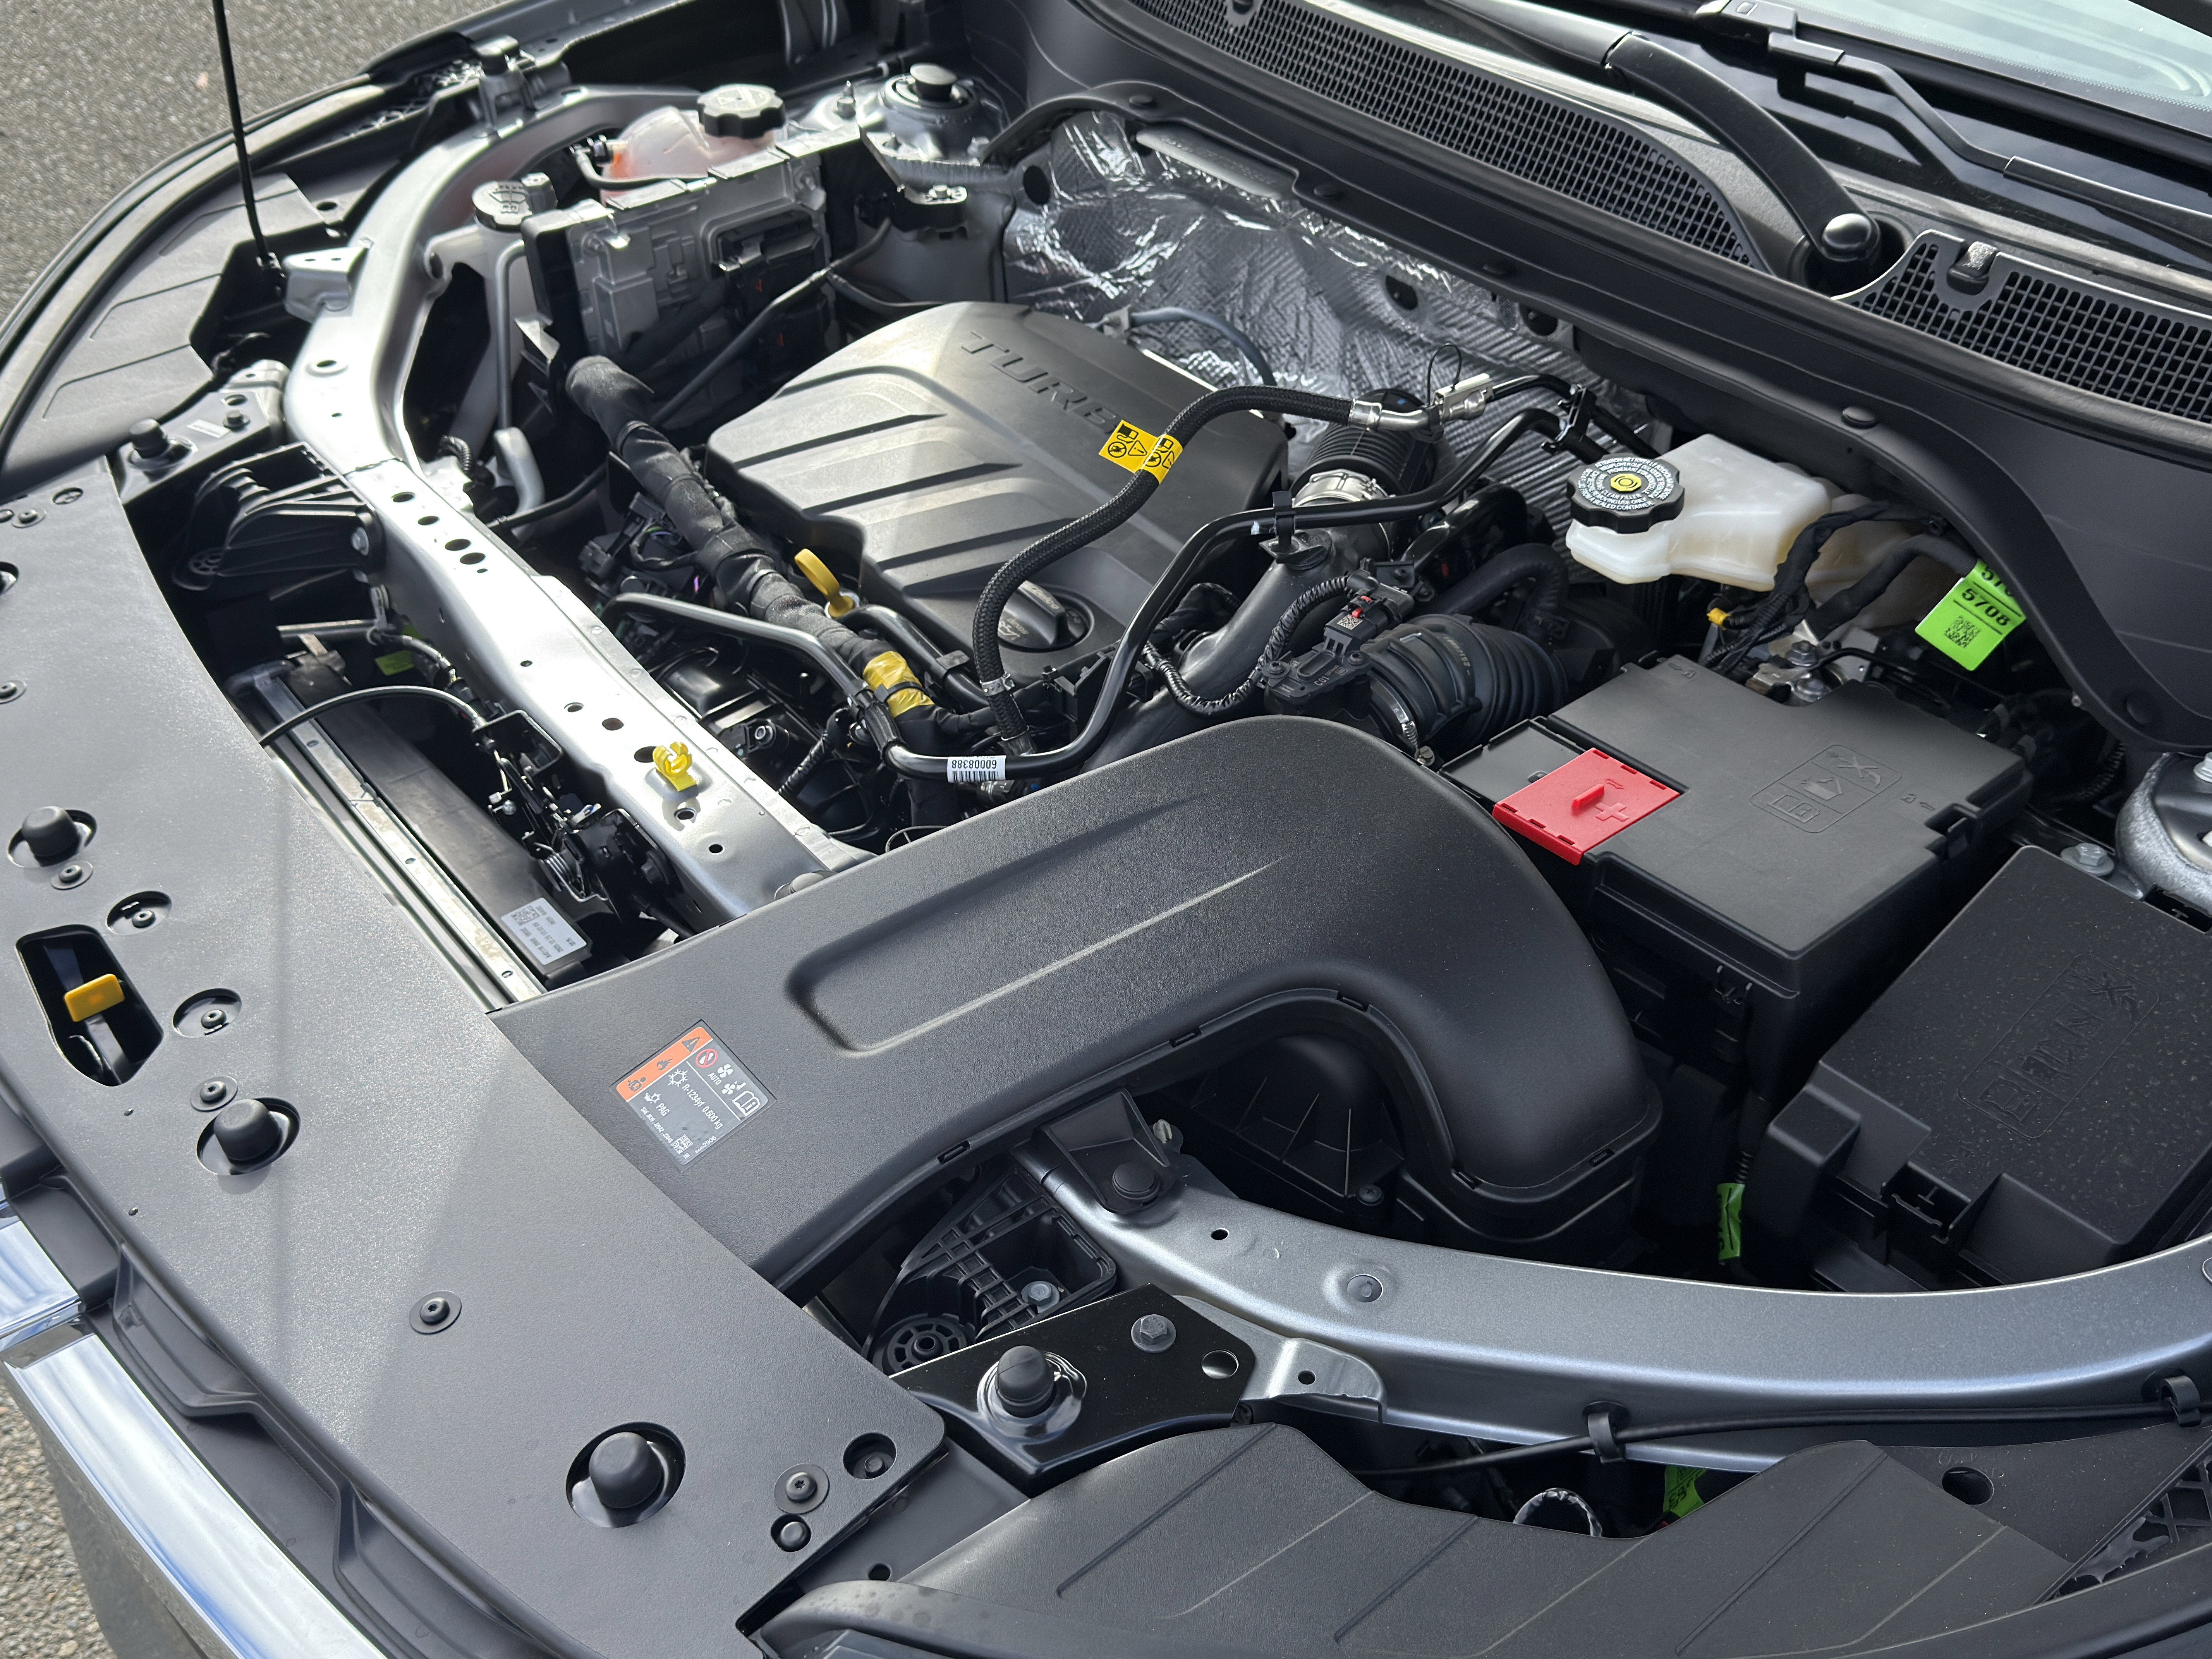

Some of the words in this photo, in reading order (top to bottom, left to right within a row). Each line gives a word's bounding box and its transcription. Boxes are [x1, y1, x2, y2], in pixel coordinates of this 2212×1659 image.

[960, 330, 1119, 434] TURB
[1962, 589, 2010, 626] 5708
[708, 1072, 722, 1085] AUTO
[656, 1103, 670, 1116] PAG
[682, 1084, 706, 1107] R-1234yf
[702, 1106, 718, 1122] 0.600
[714, 1119, 723, 1130] kg
